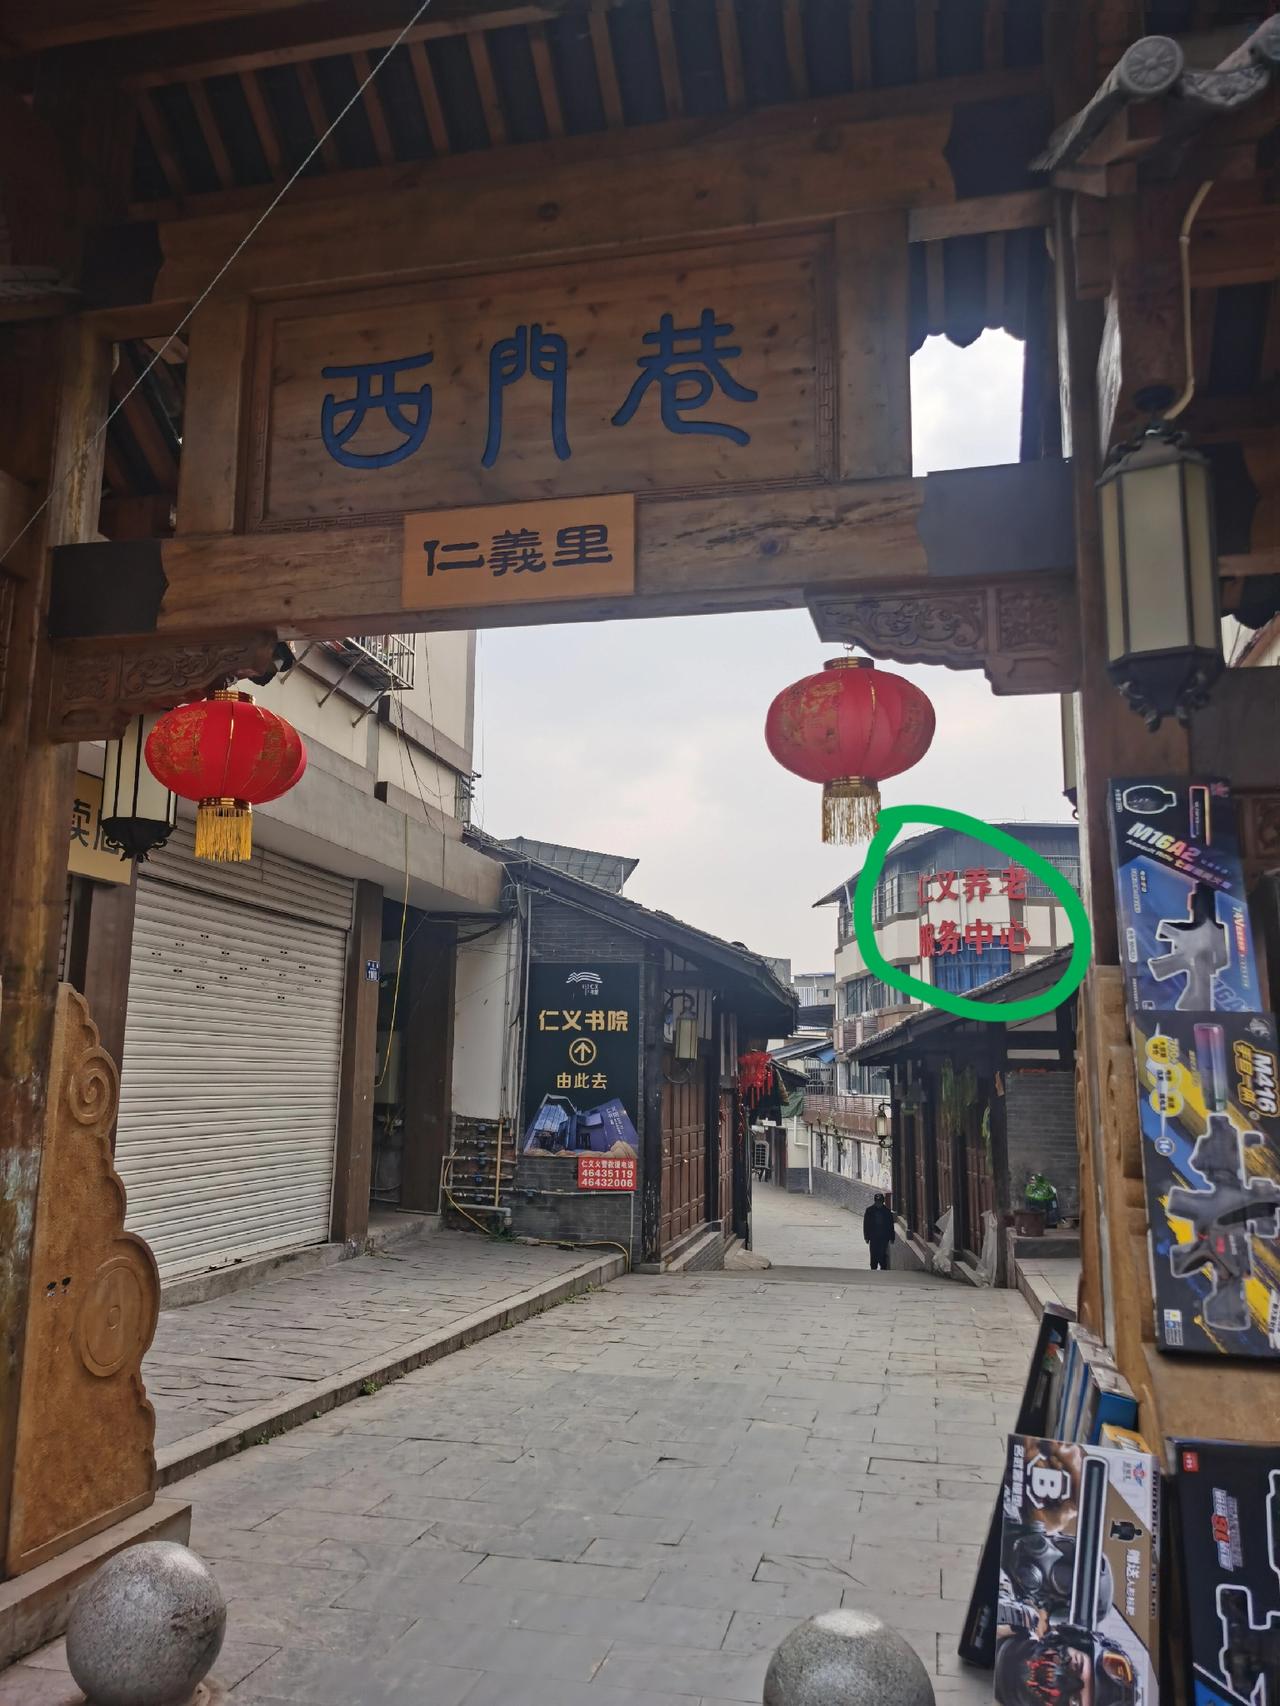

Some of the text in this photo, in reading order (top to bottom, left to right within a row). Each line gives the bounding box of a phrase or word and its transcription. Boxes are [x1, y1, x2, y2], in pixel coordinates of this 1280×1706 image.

[321, 308, 758, 470] 西門巷
[423, 524, 613, 577] 仁義里
[1127, 822, 1201, 862] M16A2
[918, 864, 1027, 907] 仁义养老
[920, 916, 1031, 957] 服务中心
[539, 1010, 628, 1031] 仁义书院
[557, 1072, 607, 1090] 由此去
[1252, 1053, 1277, 1114] M416
[582, 1169, 633, 1178] 46435119
[1032, 1466, 1062, 1499] B
